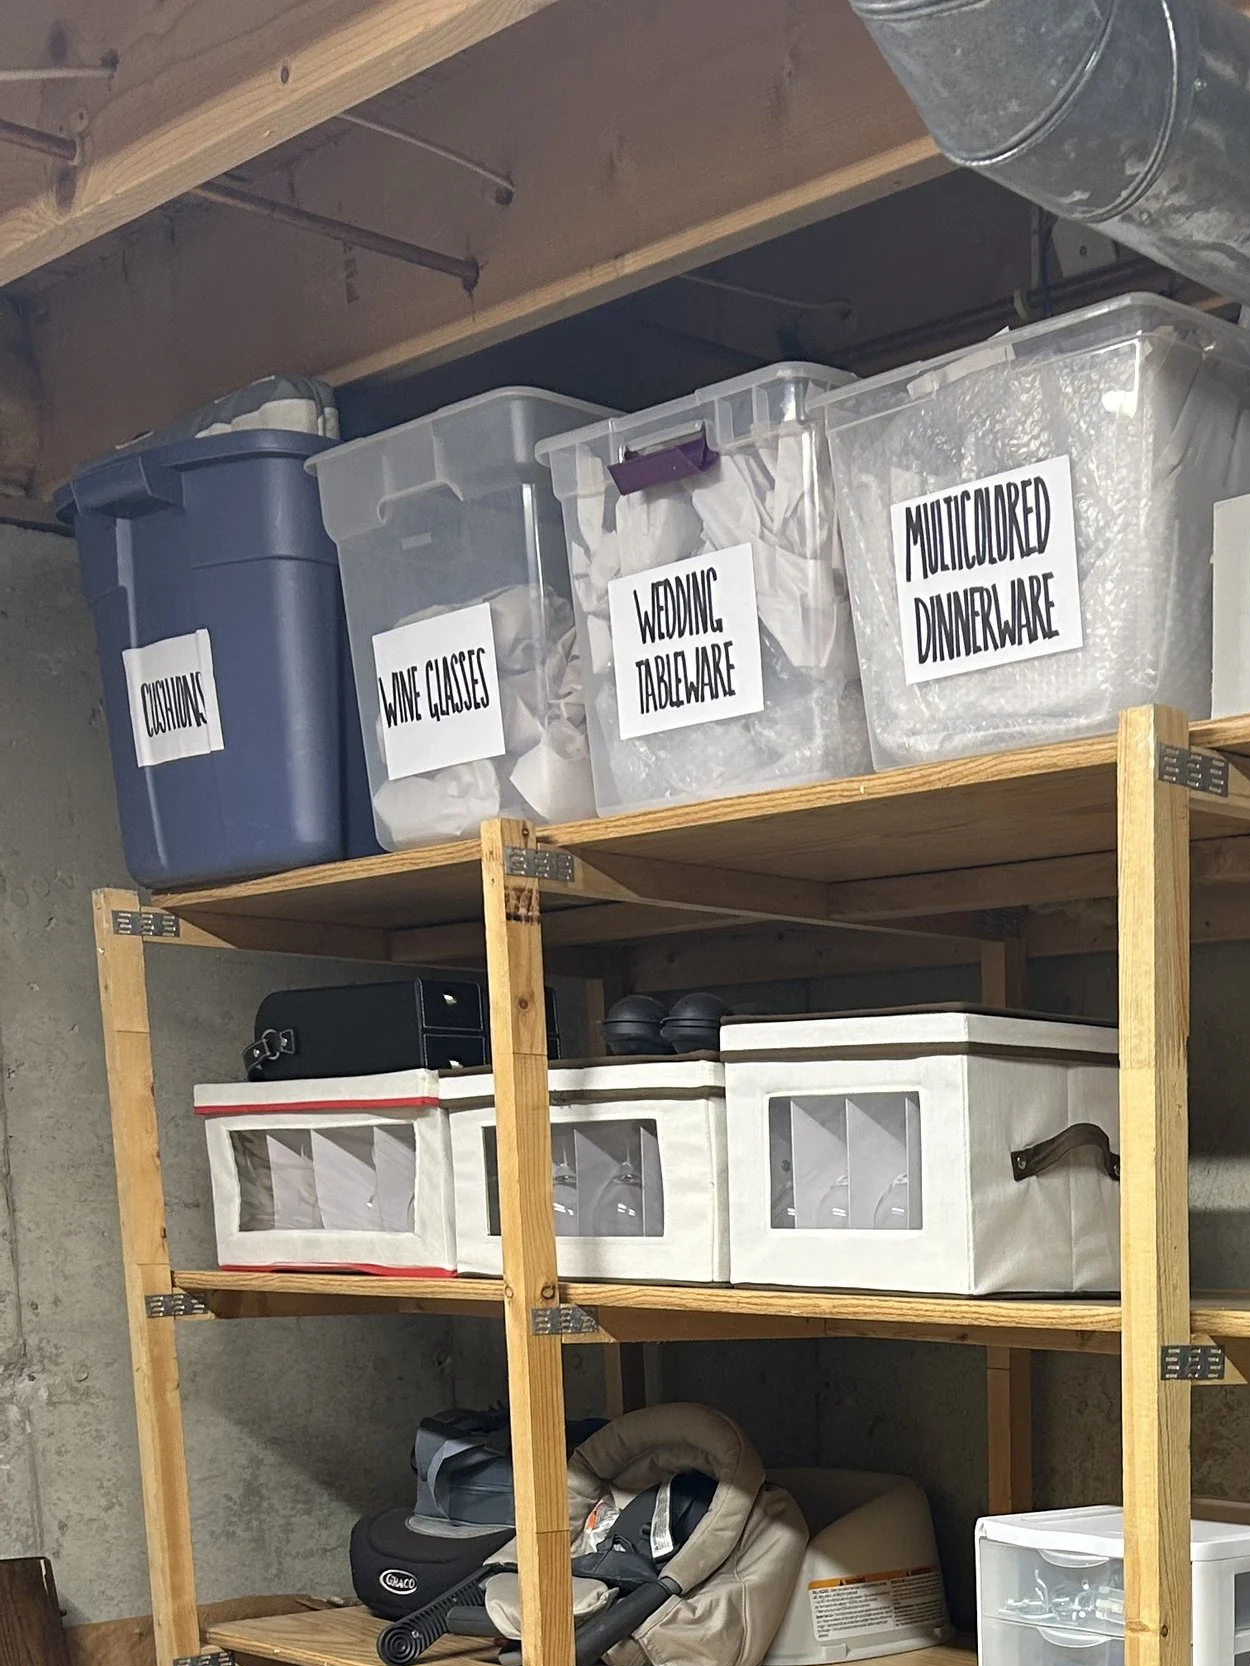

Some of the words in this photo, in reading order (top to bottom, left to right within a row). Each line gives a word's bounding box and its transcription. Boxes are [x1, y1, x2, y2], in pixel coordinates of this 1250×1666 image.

[905, 476, 1051, 582] MULTICOLORED
[633, 566, 723, 645] WEDDING
[914, 572, 1059, 665] DINNERWARE
[140, 671, 208, 738] CUSHIONS
[378, 665, 422, 729] WINE
[425, 647, 491, 722] GLASSES
[636, 640, 736, 715] TABLEWARE
